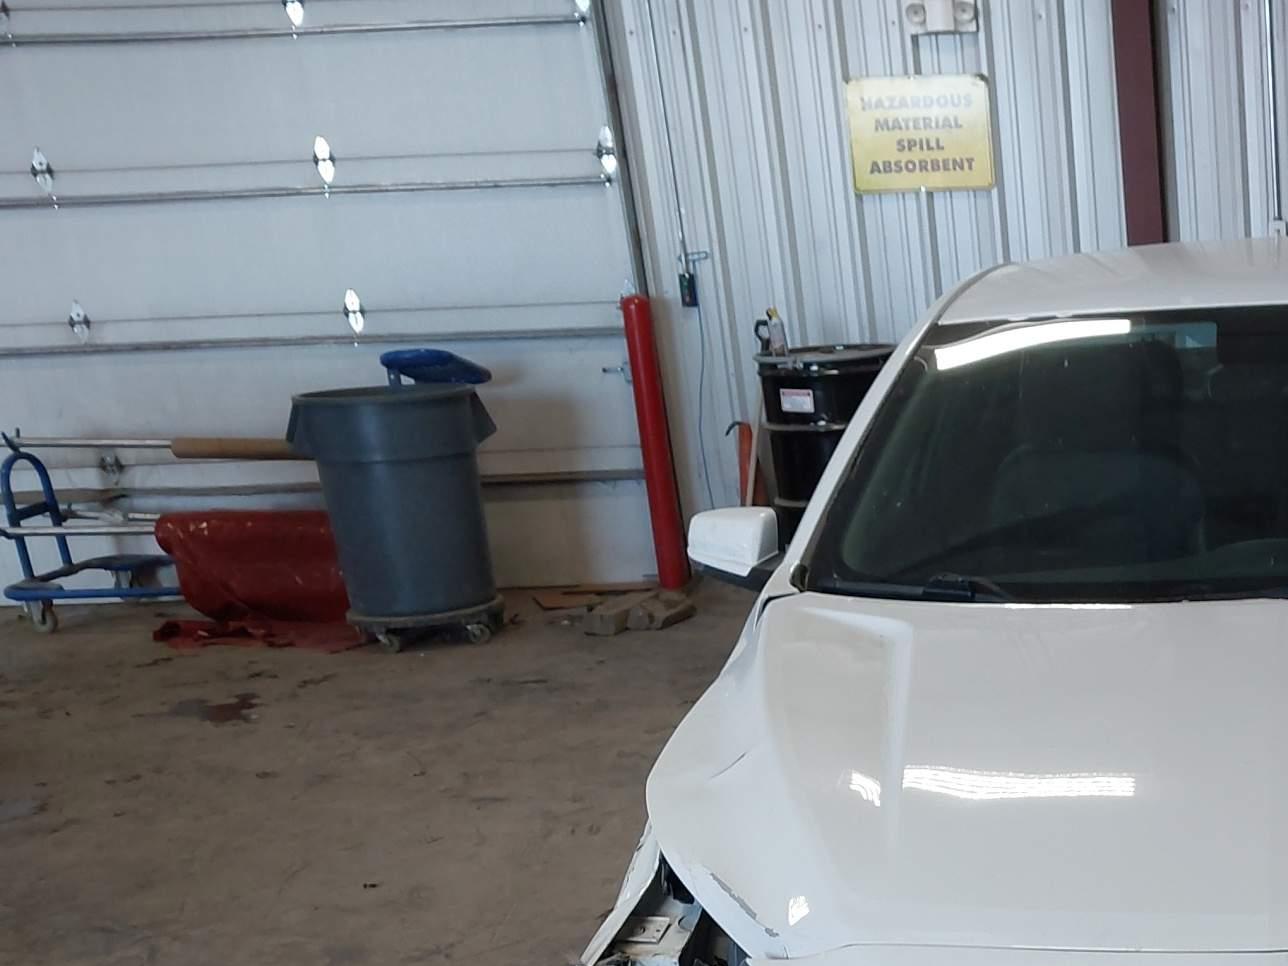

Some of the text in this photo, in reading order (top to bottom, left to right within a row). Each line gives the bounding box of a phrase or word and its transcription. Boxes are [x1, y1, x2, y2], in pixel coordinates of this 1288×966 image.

[861, 95, 972, 110] HAZARDOUS
[875, 116, 963, 132] MATERIAL
[896, 138, 945, 152] SPILL
[870, 158, 975, 174] ABSORBENT
